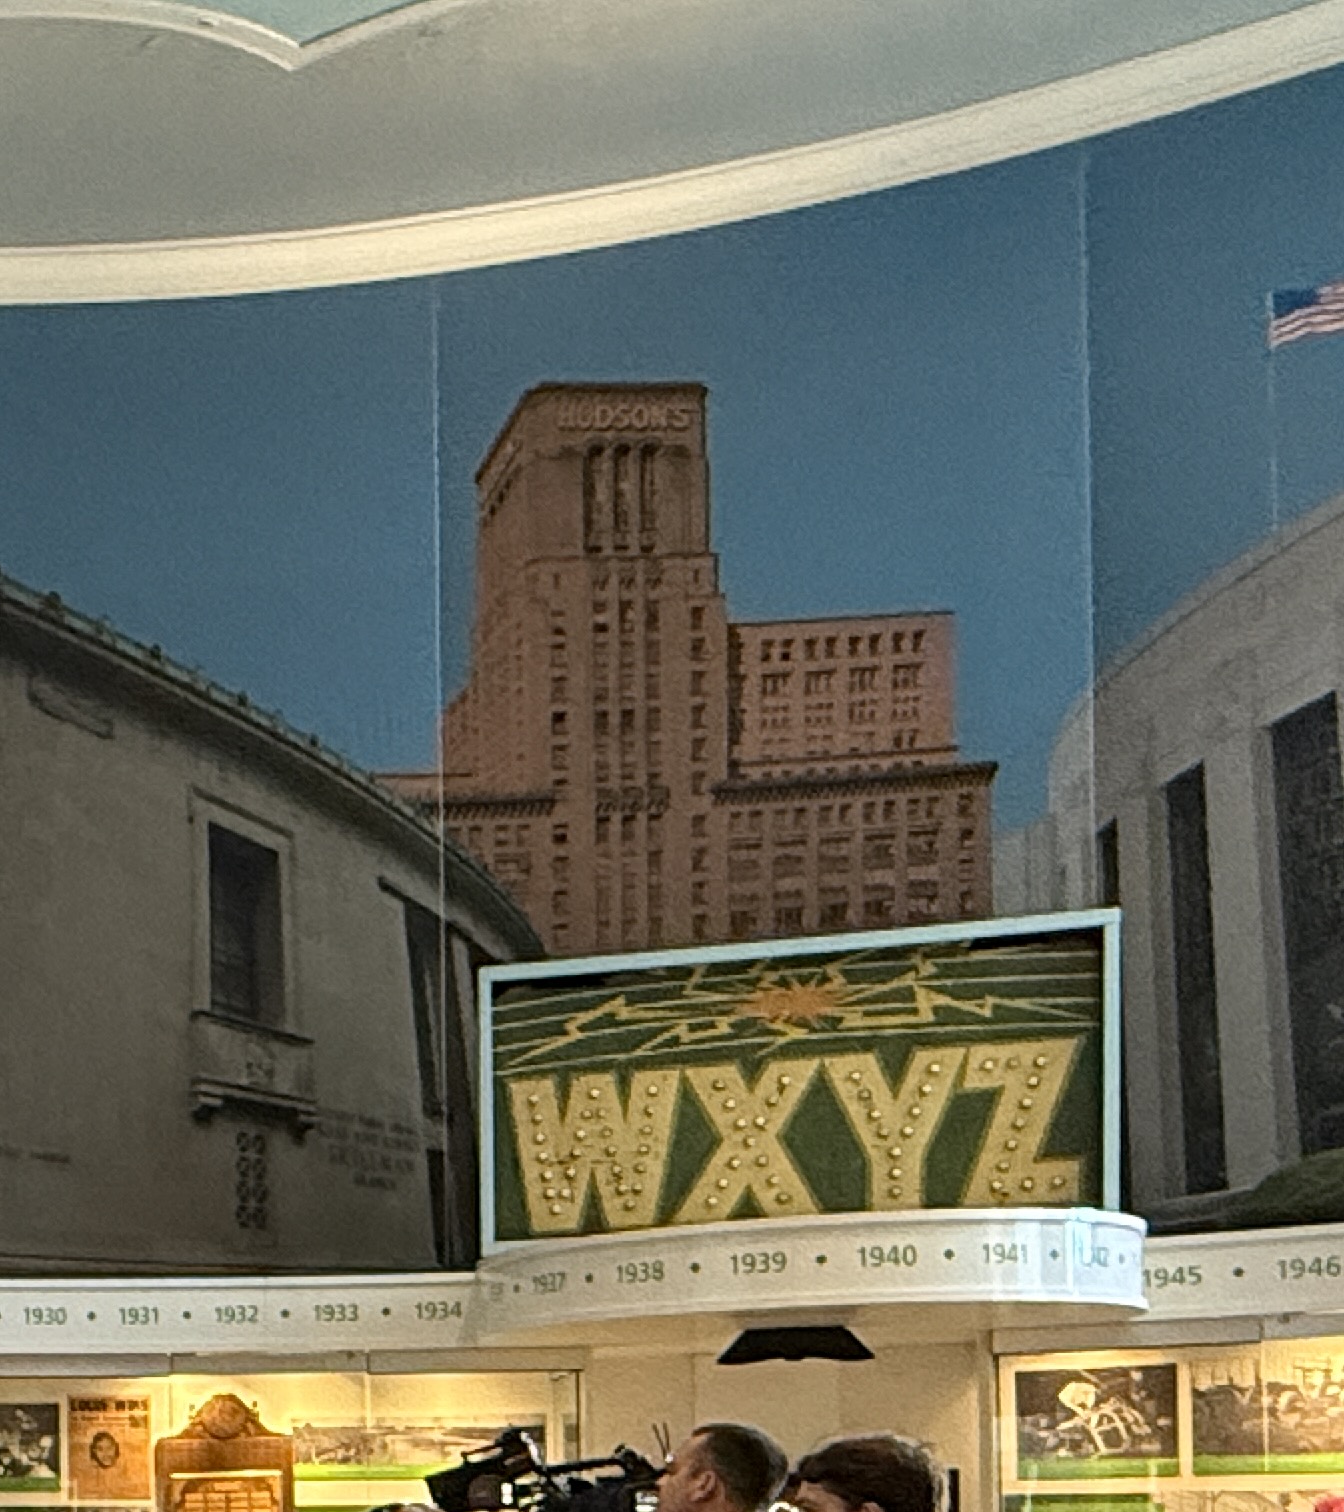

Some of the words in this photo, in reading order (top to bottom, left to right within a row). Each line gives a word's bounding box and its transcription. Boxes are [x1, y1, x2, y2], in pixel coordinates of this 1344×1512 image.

[508, 1036, 1088, 1235] WXYZ
[615, 1260, 665, 1284] 1938
[730, 1251, 788, 1275] 1939
[856, 1244, 918, 1268] 1940
[982, 1243, 1029, 1265] 1941
[1143, 1265, 1203, 1288] 1945
[1277, 1256, 1342, 1279] 1946
[23, 1306, 68, 1326] 1930
[118, 1306, 160, 1326] 1931
[214, 1305, 259, 1325] 1932
[313, 1303, 360, 1323] 1933
[414, 1301, 462, 1321] 1934
